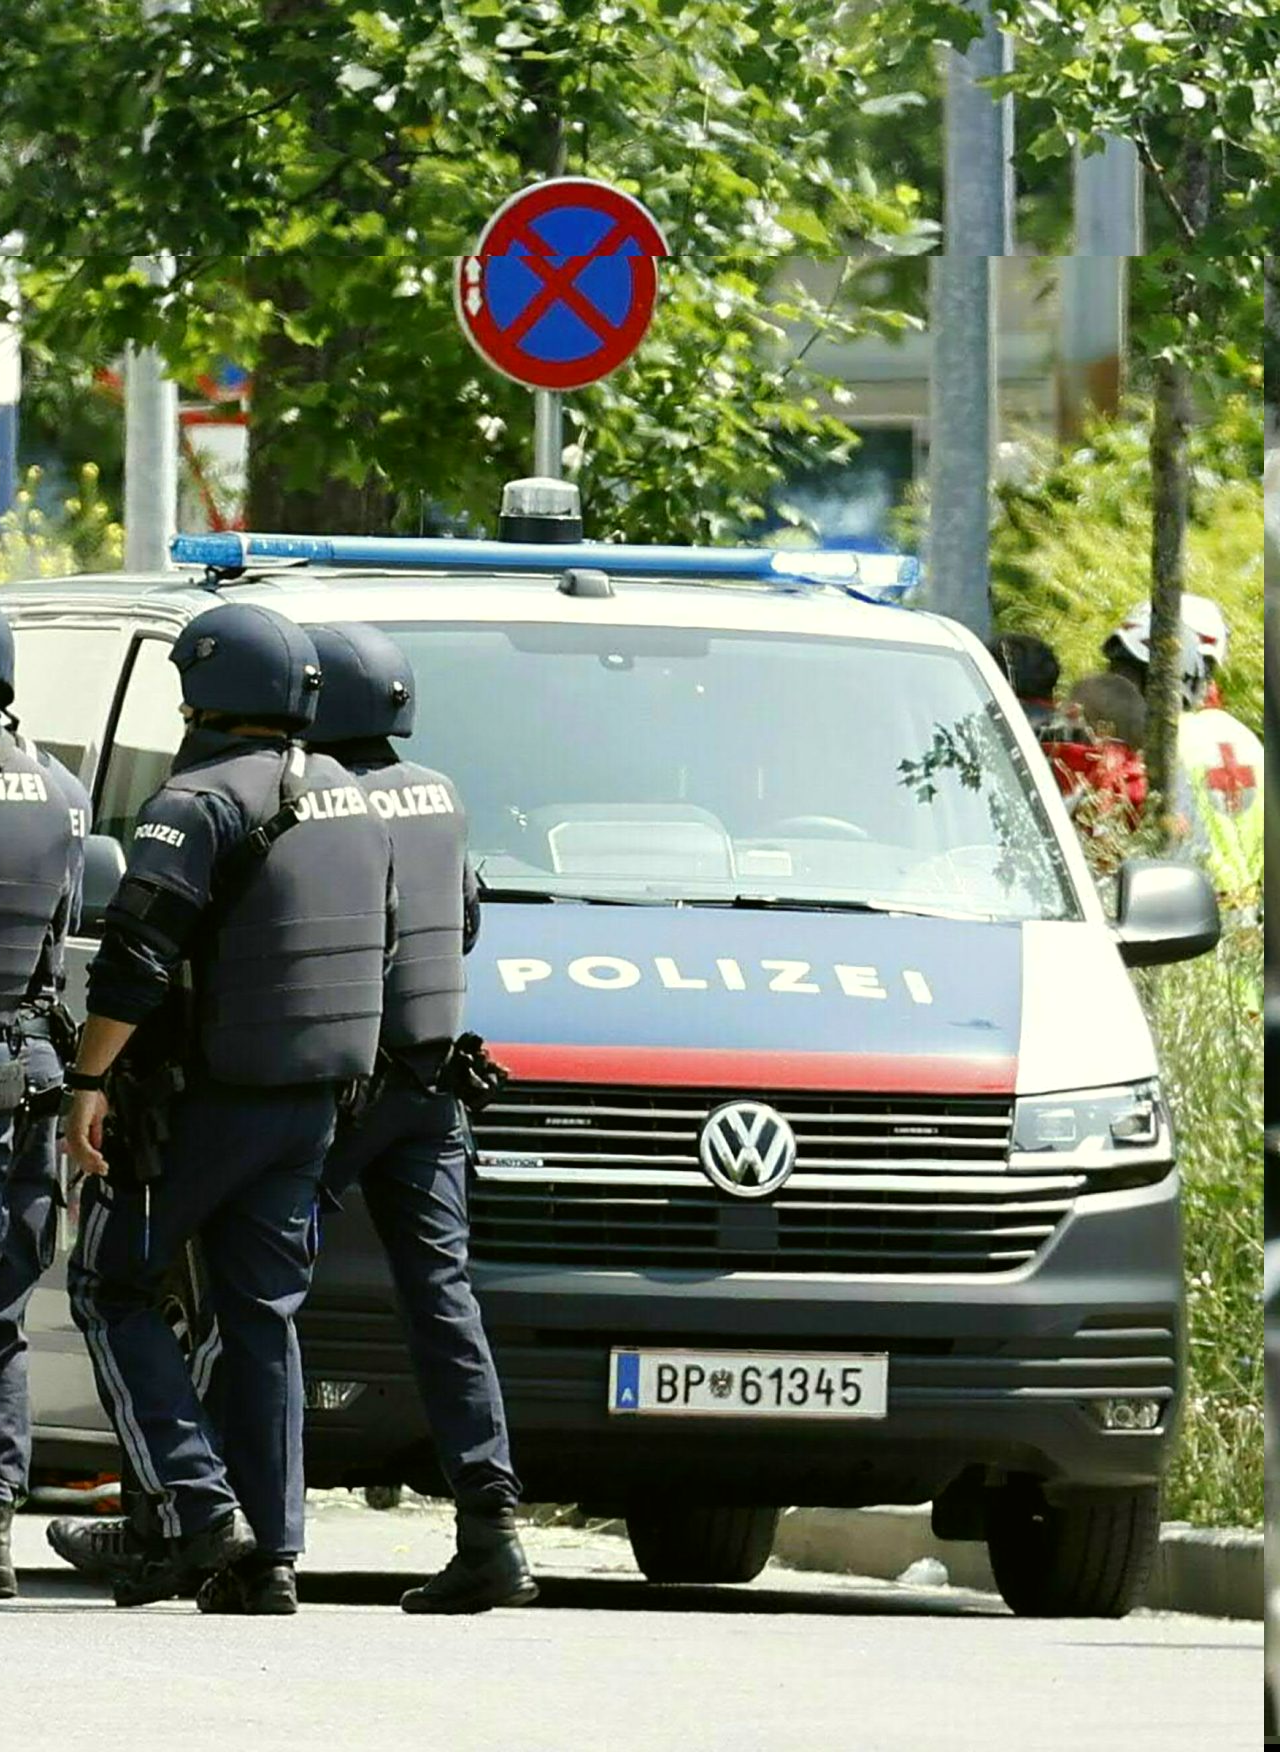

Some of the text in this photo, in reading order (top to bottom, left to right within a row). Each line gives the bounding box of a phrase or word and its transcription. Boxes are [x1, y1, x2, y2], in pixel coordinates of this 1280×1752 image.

[294, 784, 368, 822] OLIZEI
[369, 783, 455, 820] OLIZEI
[133, 822, 187, 848] POLIZEI
[496, 956, 934, 1004] POLIZEI
[655, 1363, 705, 1404] BP
[739, 1365, 863, 1407] 61345
